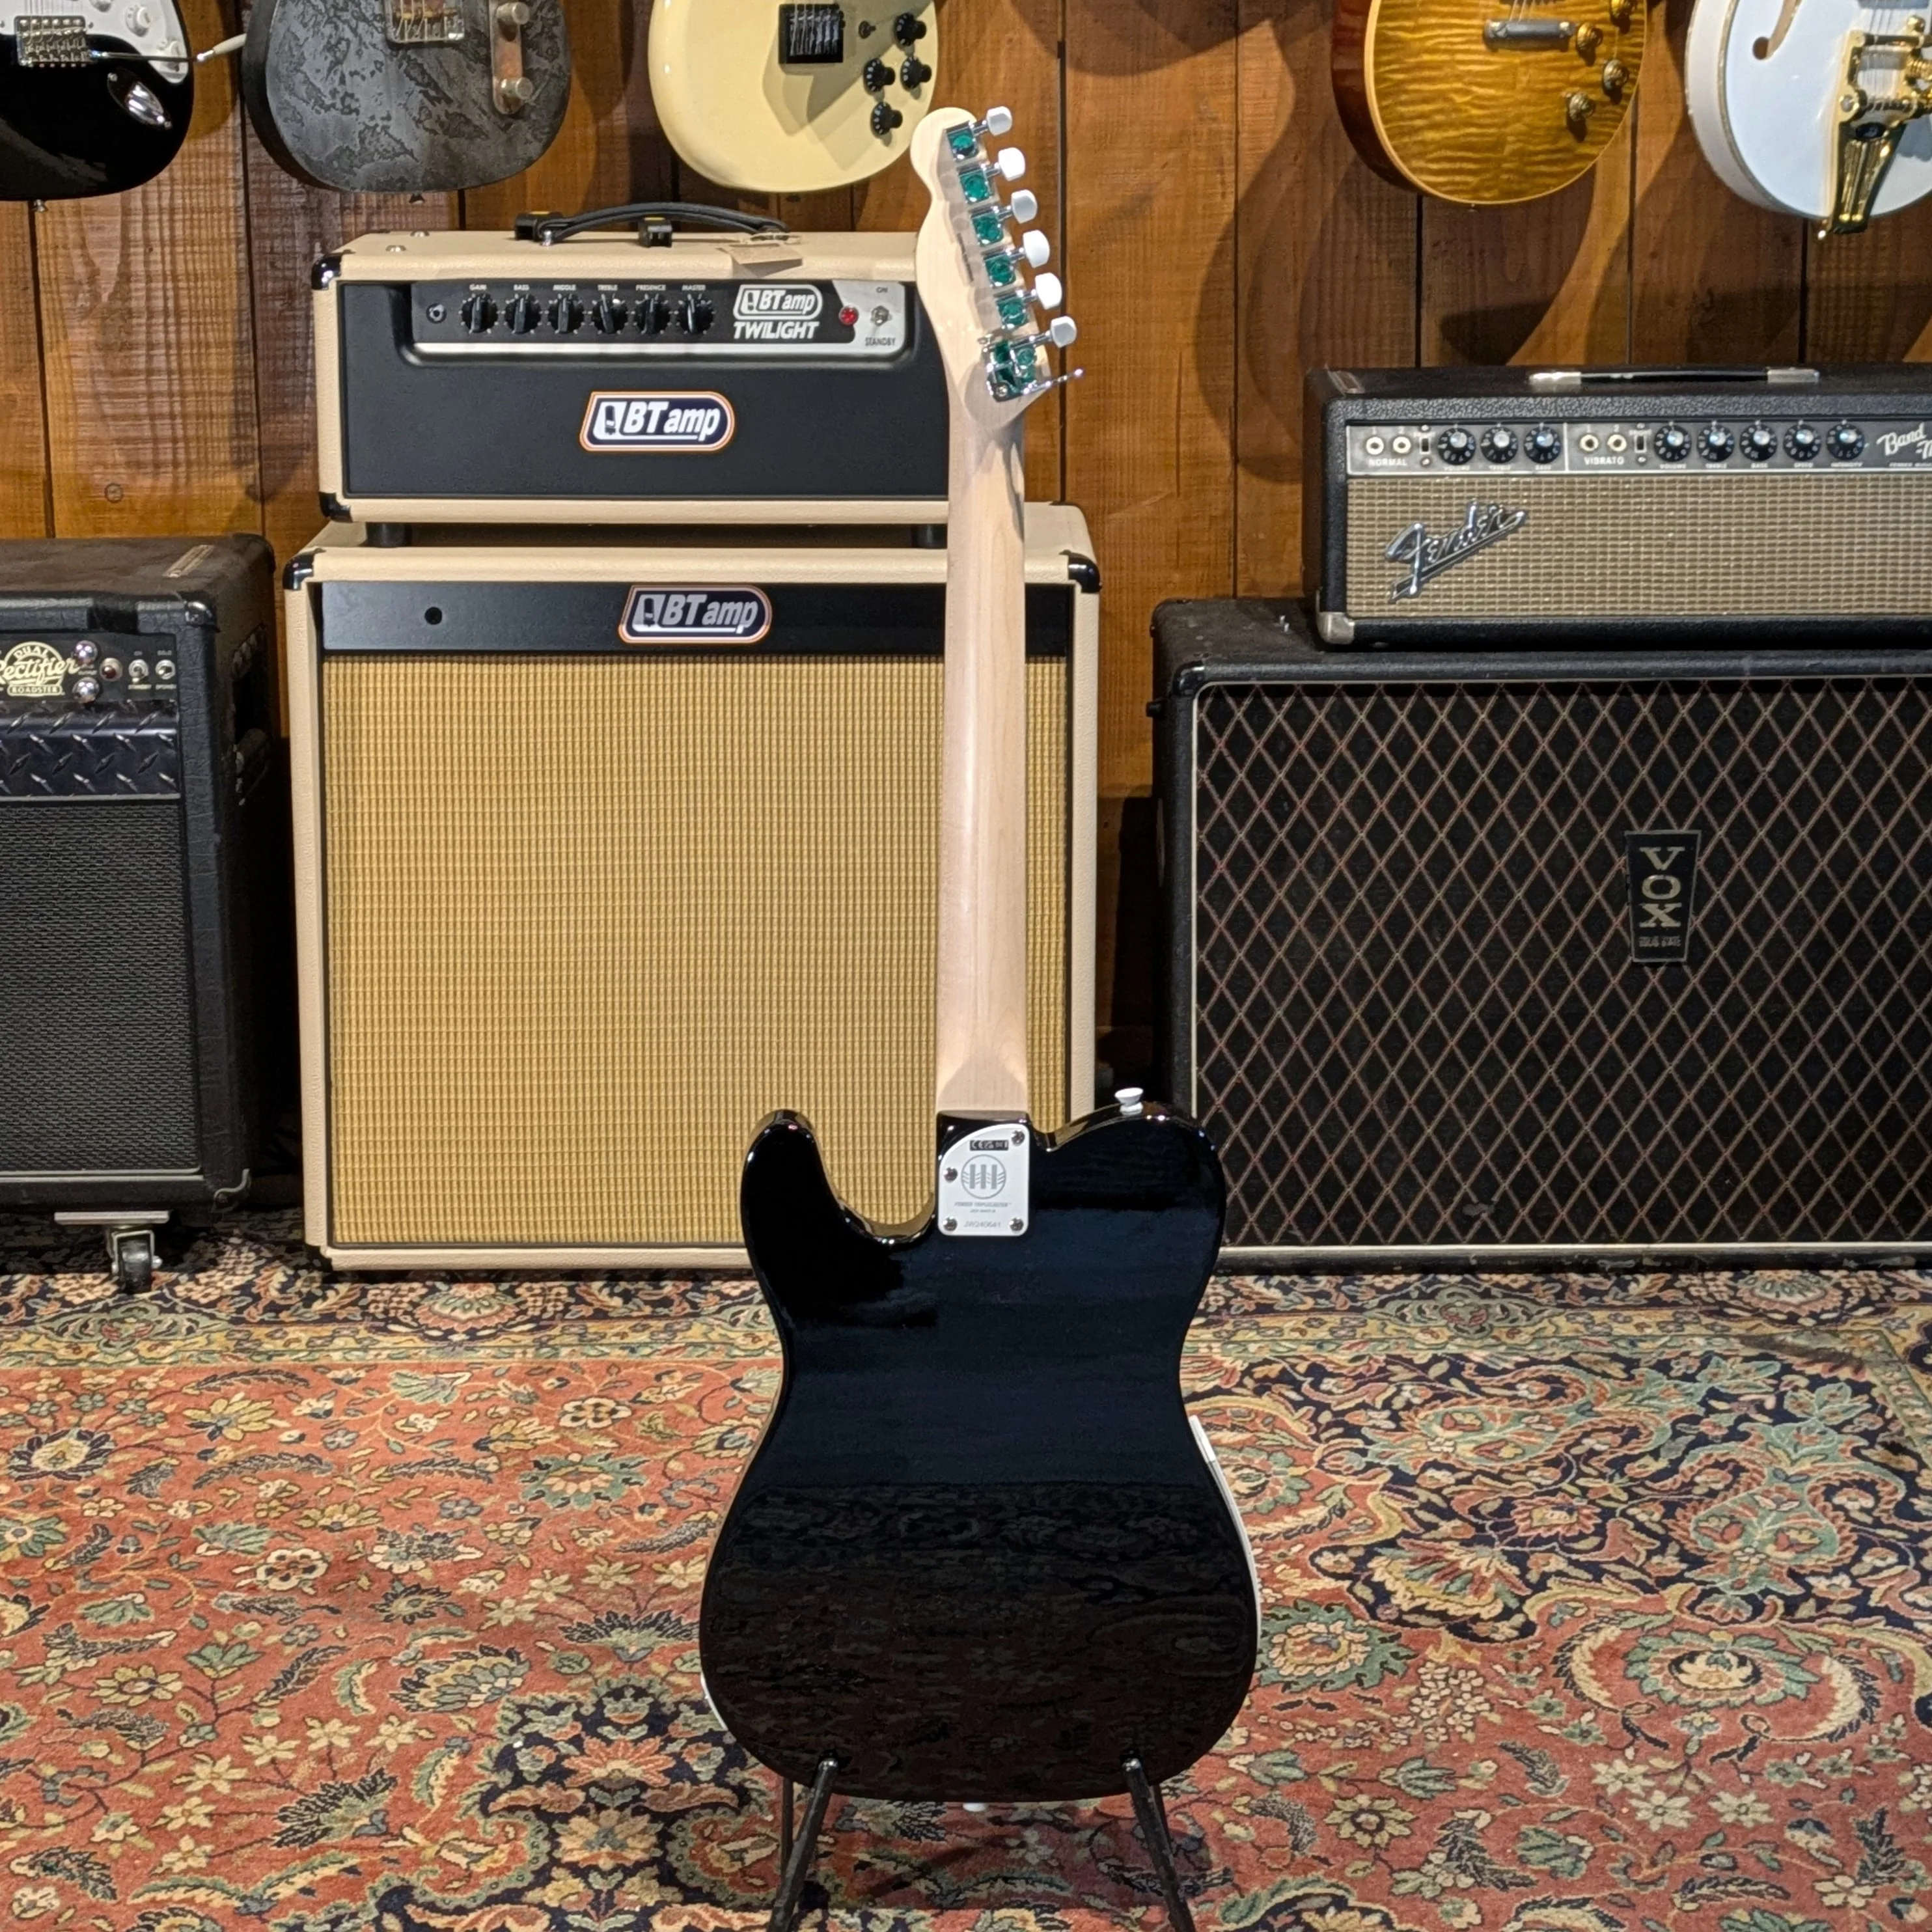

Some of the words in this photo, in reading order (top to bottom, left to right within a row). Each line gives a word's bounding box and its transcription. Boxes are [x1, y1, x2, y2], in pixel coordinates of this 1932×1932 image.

[782, 294, 816, 315] amp
[734, 321, 820, 339] TWILIGHT
[864, 337, 896, 346] STANDBY
[663, 408, 721, 442] amp
[1875, 422, 1927, 456] Band
[1368, 458, 1408, 467] NORMAL
[1584, 456, 1625, 465] VIBRATO
[1385, 497, 1526, 601] Fender
[702, 600, 759, 634] amp
[13, 645, 49, 659] DUAL
[1639, 846, 1686, 928] VOX
